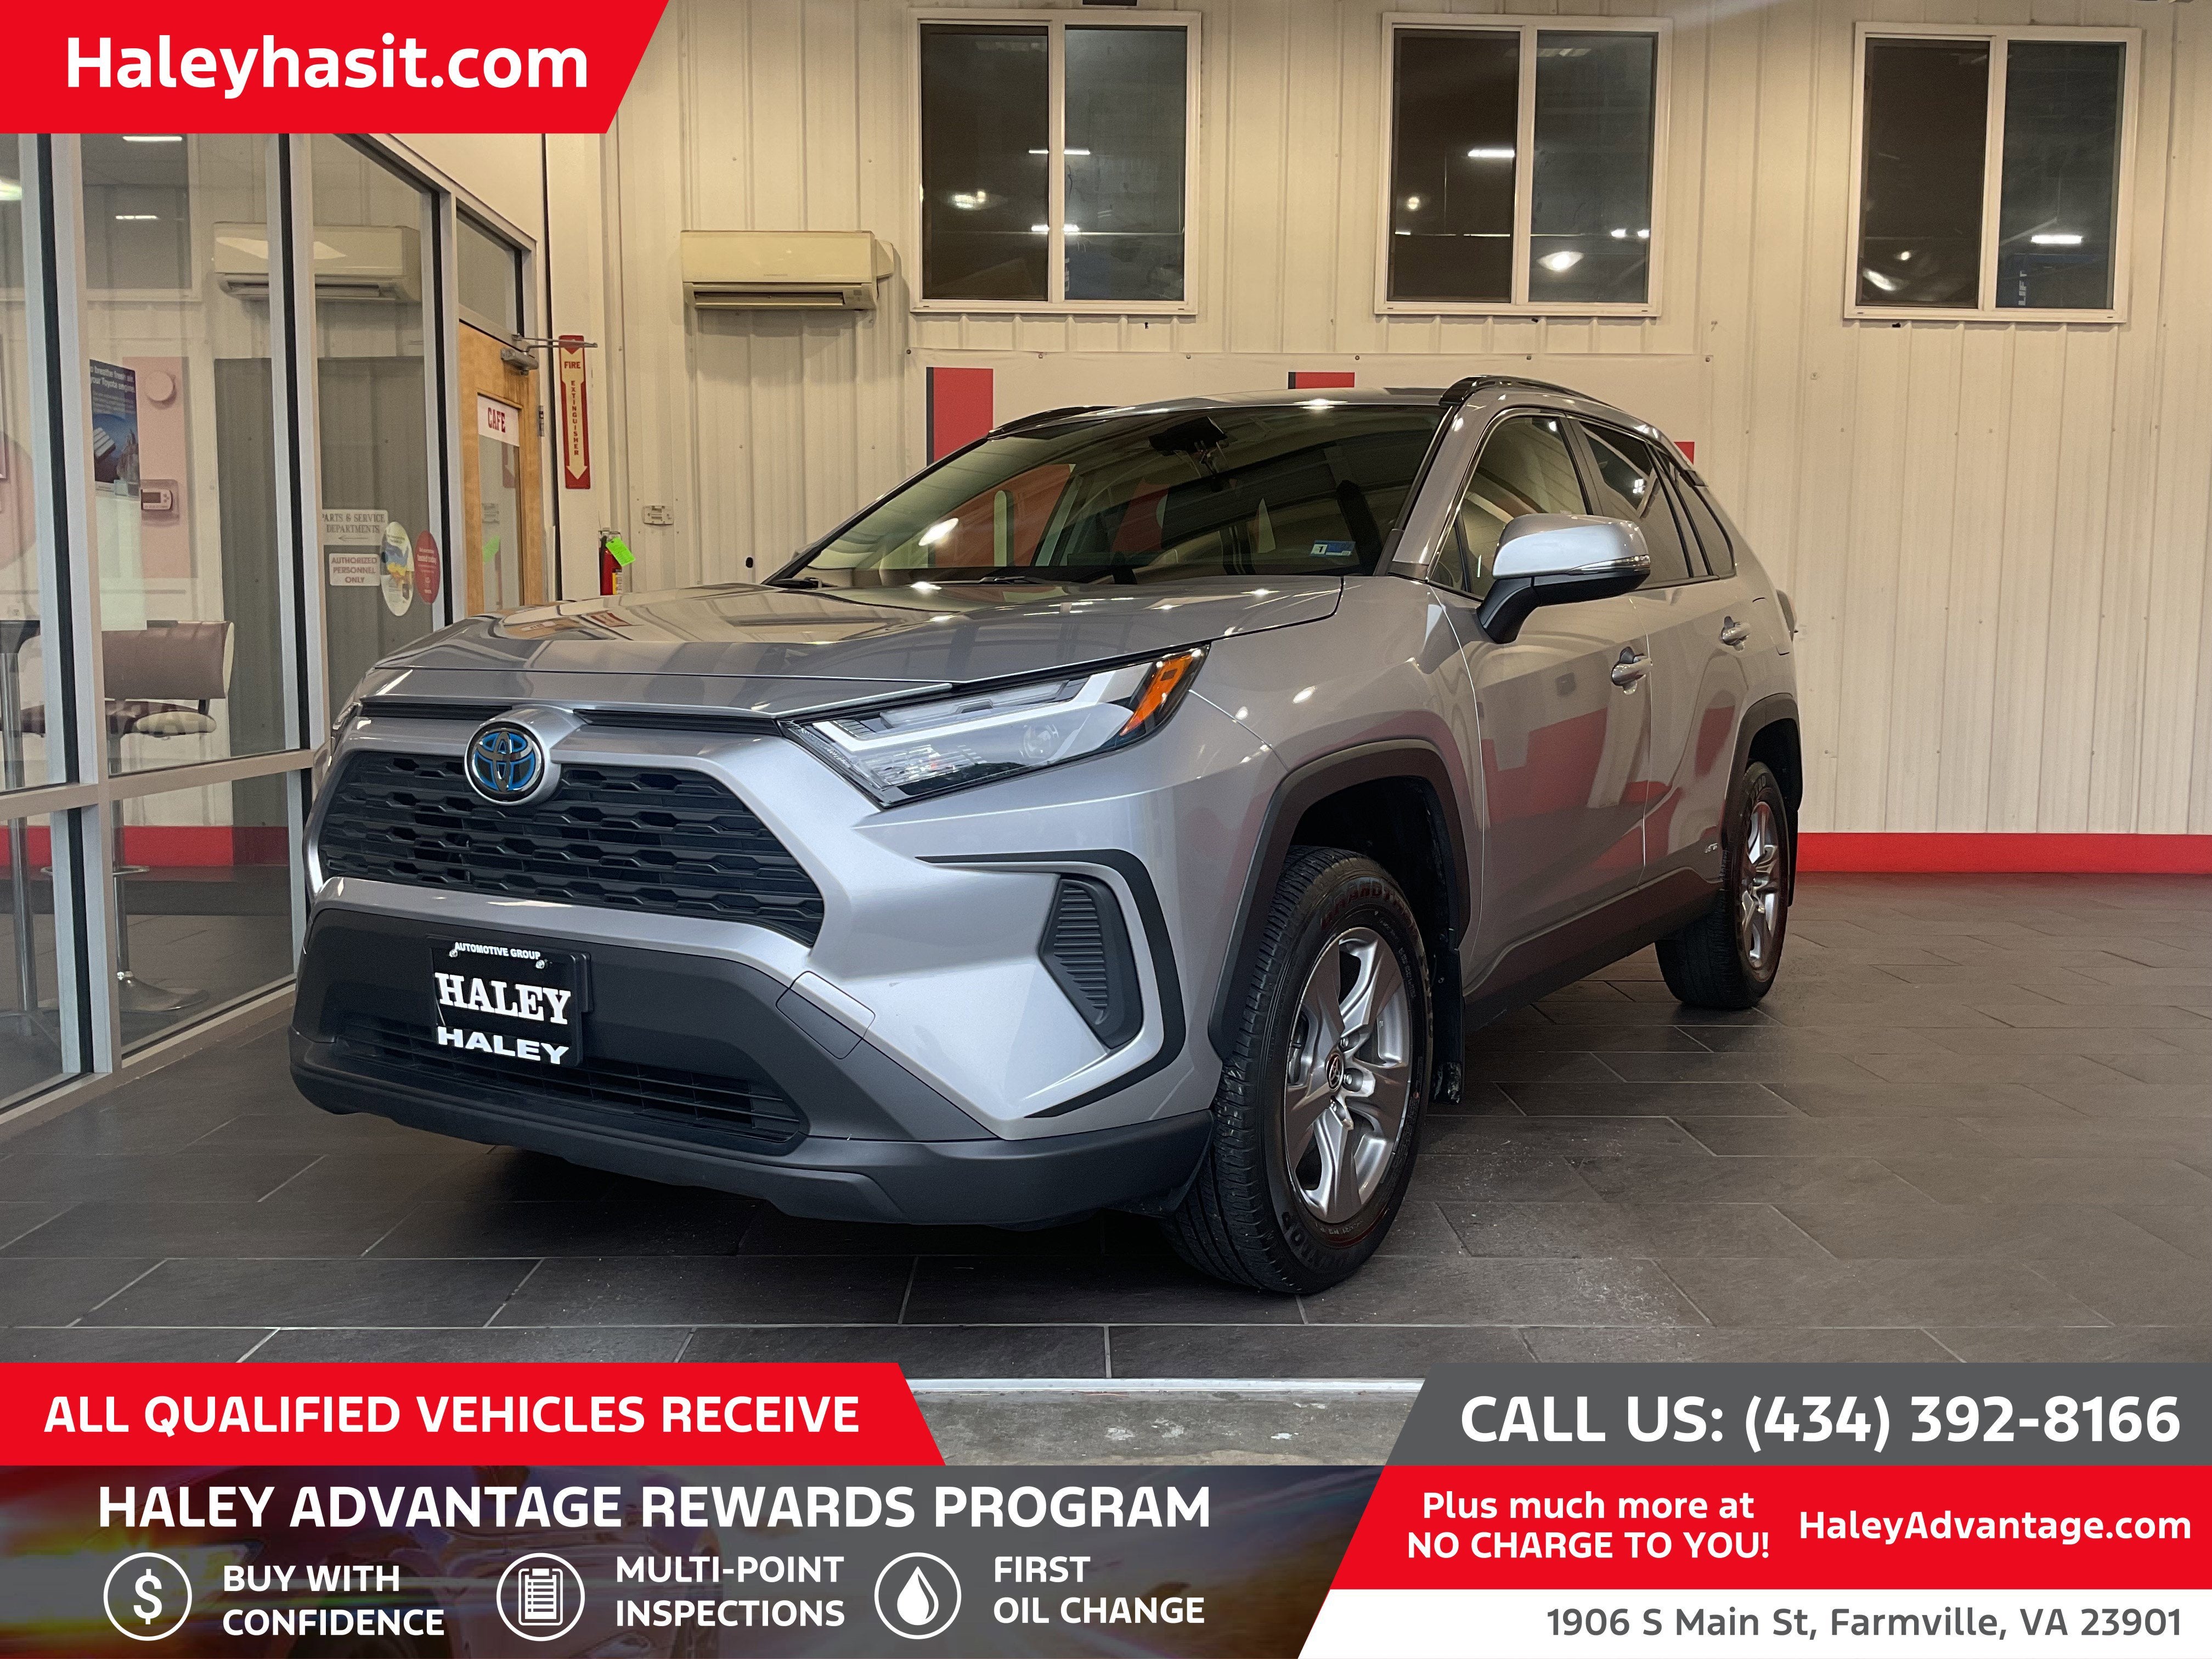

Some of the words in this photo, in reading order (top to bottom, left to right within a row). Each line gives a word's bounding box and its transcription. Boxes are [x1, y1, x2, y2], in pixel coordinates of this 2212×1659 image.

[564, 361, 581, 369] FIRE
[488, 407, 506, 433] CAFE
[354, 514, 385, 522] SERVICE
[326, 524, 380, 534] DEPARTMENTS
[454, 941, 509, 957] AUTOMOTIVE
[510, 949, 541, 960] GROUP
[435, 972, 571, 1025] HALEY
[437, 1026, 569, 1065] HALEY
